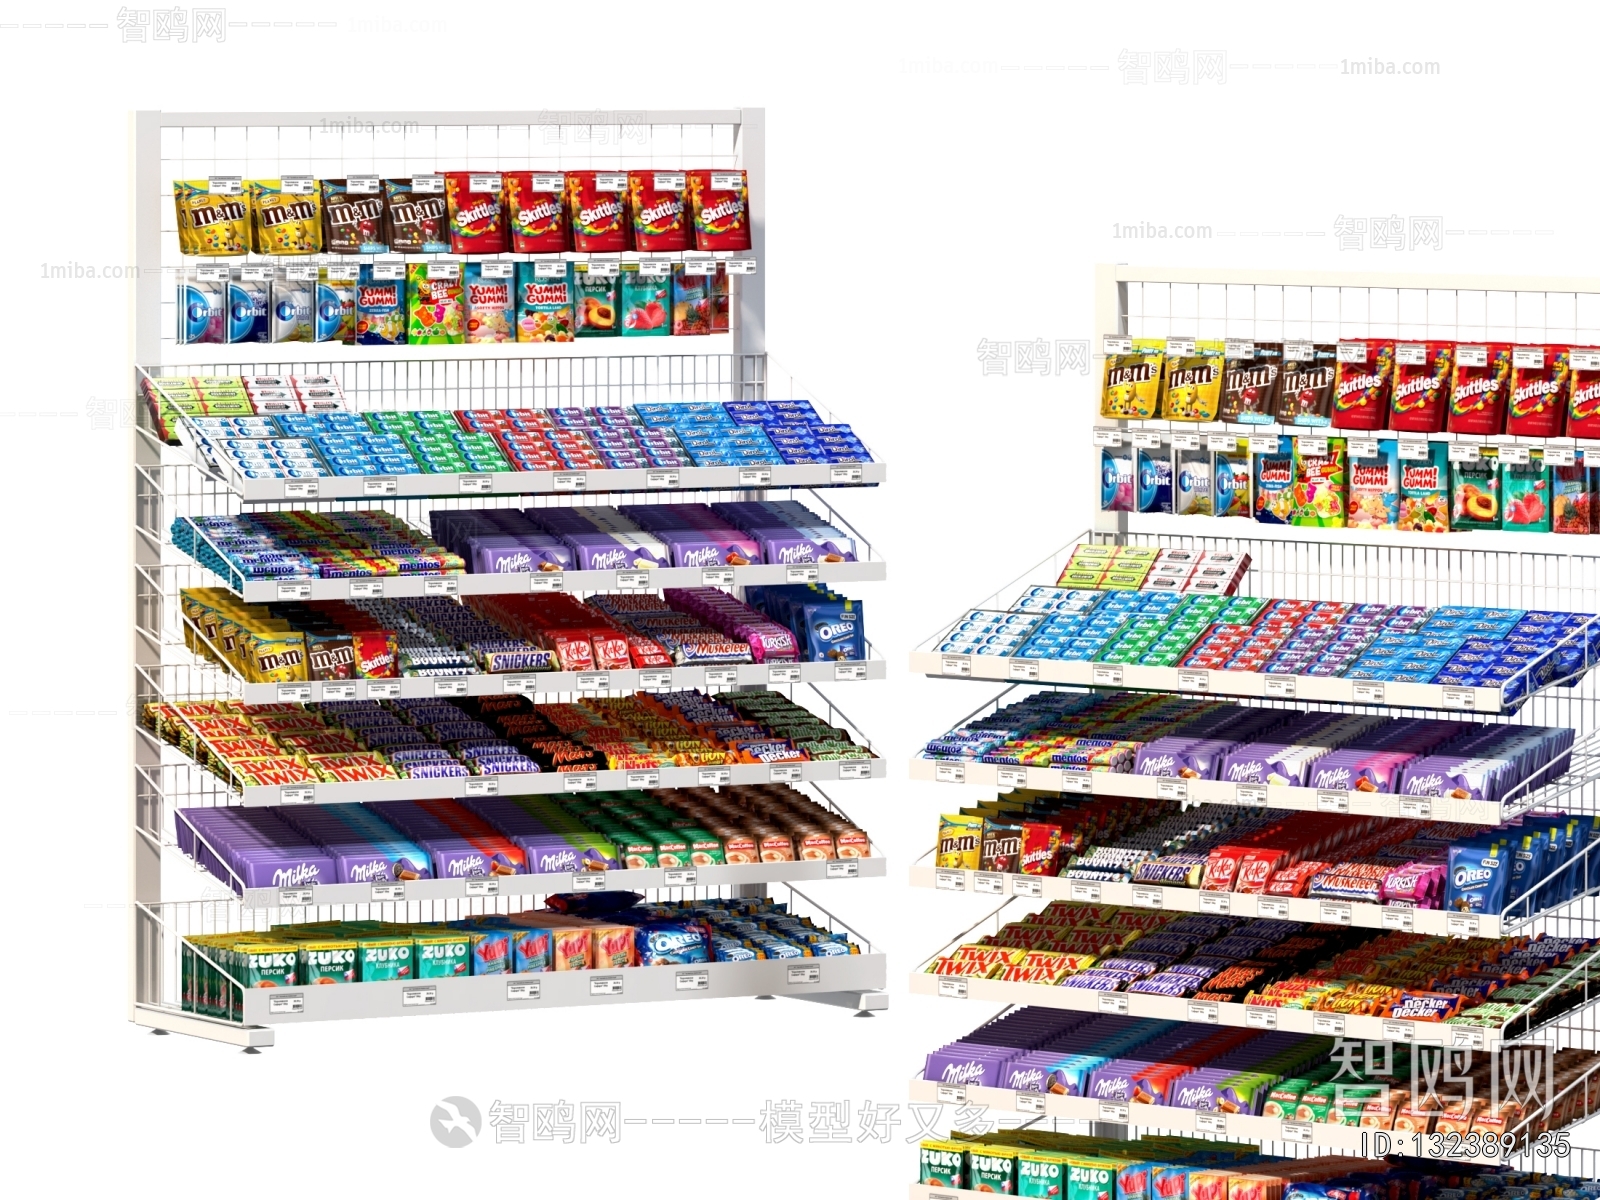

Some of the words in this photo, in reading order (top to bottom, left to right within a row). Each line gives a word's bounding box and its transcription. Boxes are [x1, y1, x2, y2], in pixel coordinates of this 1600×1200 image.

[456, 201, 501, 227] Skittles
[518, 201, 562, 227] Skittles
[580, 200, 624, 227] Skittles
[641, 199, 686, 226] Skittles
[701, 198, 745, 225] Skittles
[431, 289, 447, 299] BEE
[187, 302, 223, 323] Orbit
[231, 302, 267, 323] Orbit
[275, 301, 311, 322] Orbit
[318, 301, 353, 322] Orbit
[1338, 375, 1382, 400] Skittles
[1396, 376, 1440, 401] Skittles
[1454, 378, 1499, 402] Skittles
[1513, 380, 1558, 404] Skittles
[1102, 467, 1132, 492] Orbit
[1140, 469, 1170, 493] Orbit
[1305, 466, 1321, 477] BEE
[1179, 471, 1209, 492] Orbit
[1217, 473, 1248, 495] Orbit
[591, 549, 628, 571] Milka
[683, 546, 720, 567] Milka
[778, 543, 815, 565] Milka
[495, 553, 532, 575] Milka
[818, 621, 854, 642] OREO
[565, 640, 590, 660] KitKat
[600, 640, 625, 660] KitKat
[695, 642, 751, 659] Musketeer
[361, 654, 394, 673] Skittles
[493, 652, 551, 671] SNICKERS
[369, 733, 425, 747] SNICKERS
[392, 751, 450, 764] SNICKERS
[464, 746, 519, 759] SNICKERS
[552, 751, 594, 764] Mars
[759, 750, 801, 763] Decker
[413, 766, 468, 779] SNICKERS
[482, 762, 540, 775] SNICKERS
[449, 857, 485, 877] Milka
[540, 851, 576, 872] Milka
[1022, 850, 1053, 866] Skittles
[1209, 859, 1233, 876] KitKat
[273, 863, 320, 887] Milka
[350, 860, 387, 882] Milka
[1136, 863, 1191, 880] SNICKERS
[1242, 860, 1267, 878] KitKat
[1454, 868, 1492, 887] OREO
[1324, 875, 1381, 891] Musketeer
[654, 932, 701, 951] OREO
[249, 953, 296, 968] ZUKO
[308, 951, 355, 966] ZUKO
[365, 948, 410, 962] ZUKO
[422, 945, 466, 959] ZUKO
[732, 952, 753, 962] OREO
[779, 950, 800, 960] OREO
[825, 947, 846, 957] OREO
[261, 967, 285, 976] ПЕРСИК
[320, 965, 344, 973] ПЕРСИК
[1129, 979, 1185, 996] SNICKERS
[1151, 972, 1203, 990] SNICKERS
[1393, 1006, 1437, 1019] Decker
[942, 1061, 985, 1083] Milka
[1010, 1070, 1043, 1089] Milka
[1096, 1078, 1129, 1097] Milka
[1179, 1086, 1213, 1106] Milka
[921, 1150, 961, 1167] ZUKO
[971, 1155, 1012, 1172] ZUKO
[931, 1166, 951, 1174] ПЕРСИК
[981, 1171, 1002, 1180] ПЕРСИК
[1021, 1161, 1060, 1177] ZUKO
[1071, 1168, 1109, 1184] ZUKO
